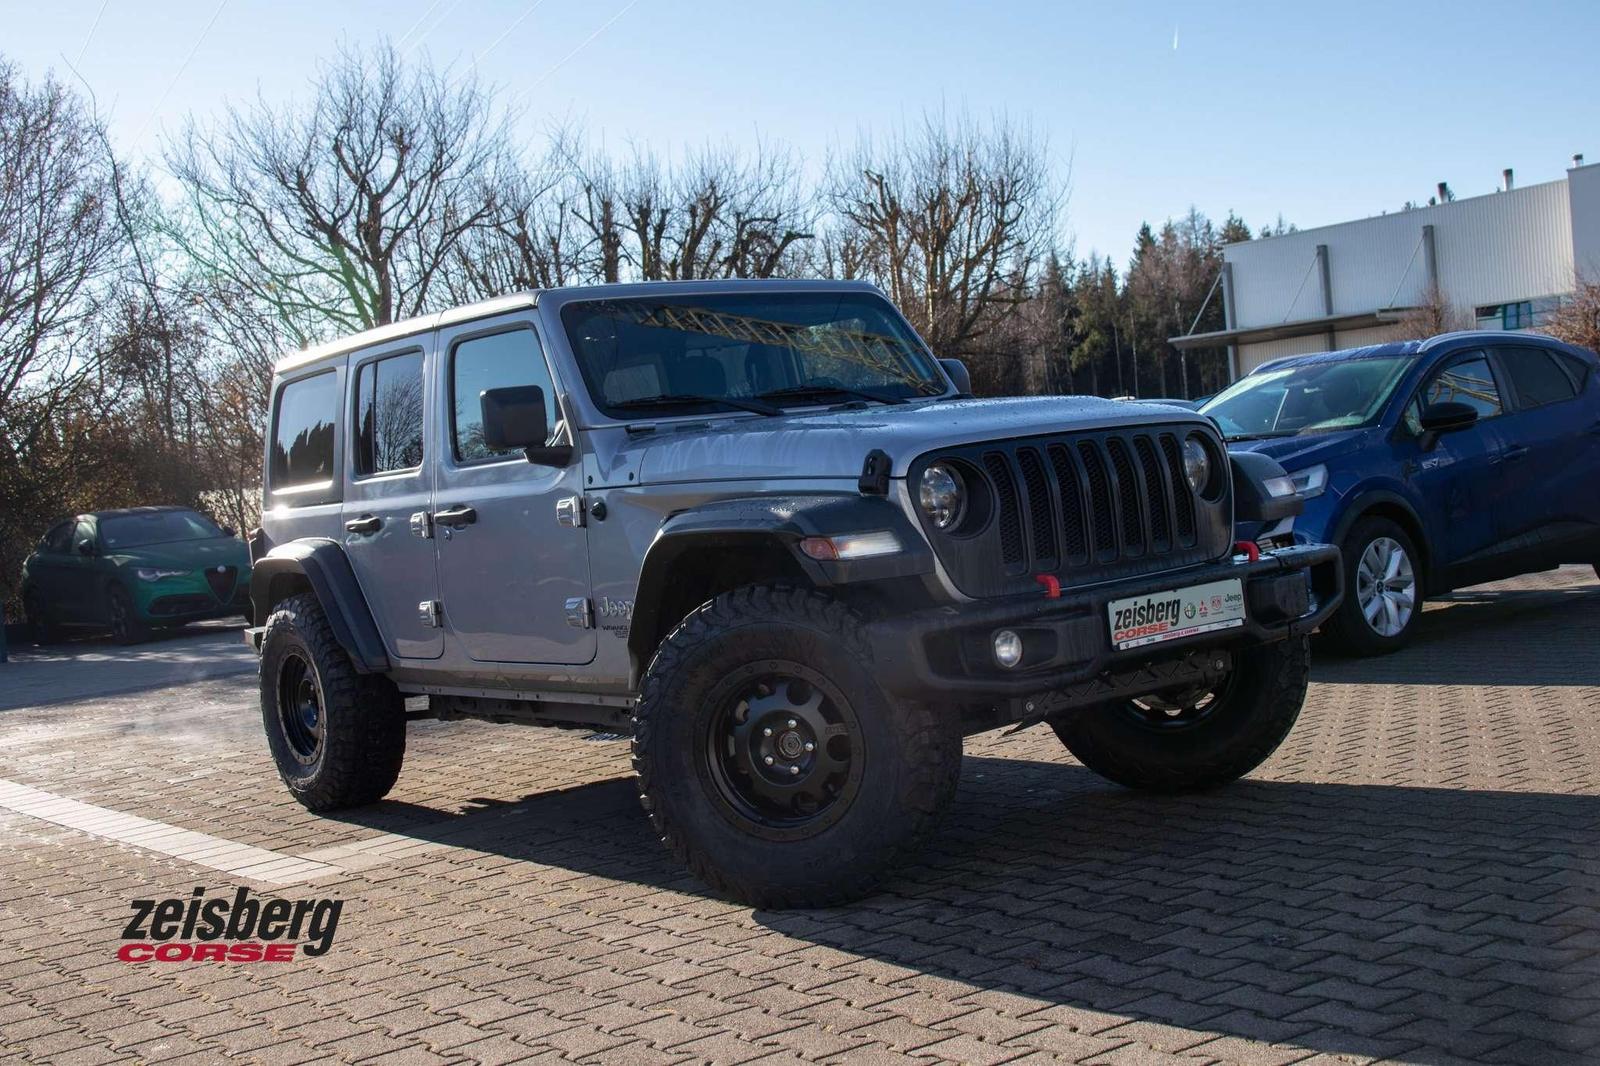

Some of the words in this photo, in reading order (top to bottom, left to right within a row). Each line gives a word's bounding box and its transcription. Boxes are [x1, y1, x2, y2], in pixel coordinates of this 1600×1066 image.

[1225, 593, 1242, 604] Jeep
[1114, 598, 1181, 631] zeisberg
[1114, 621, 1169, 641] CORSE
